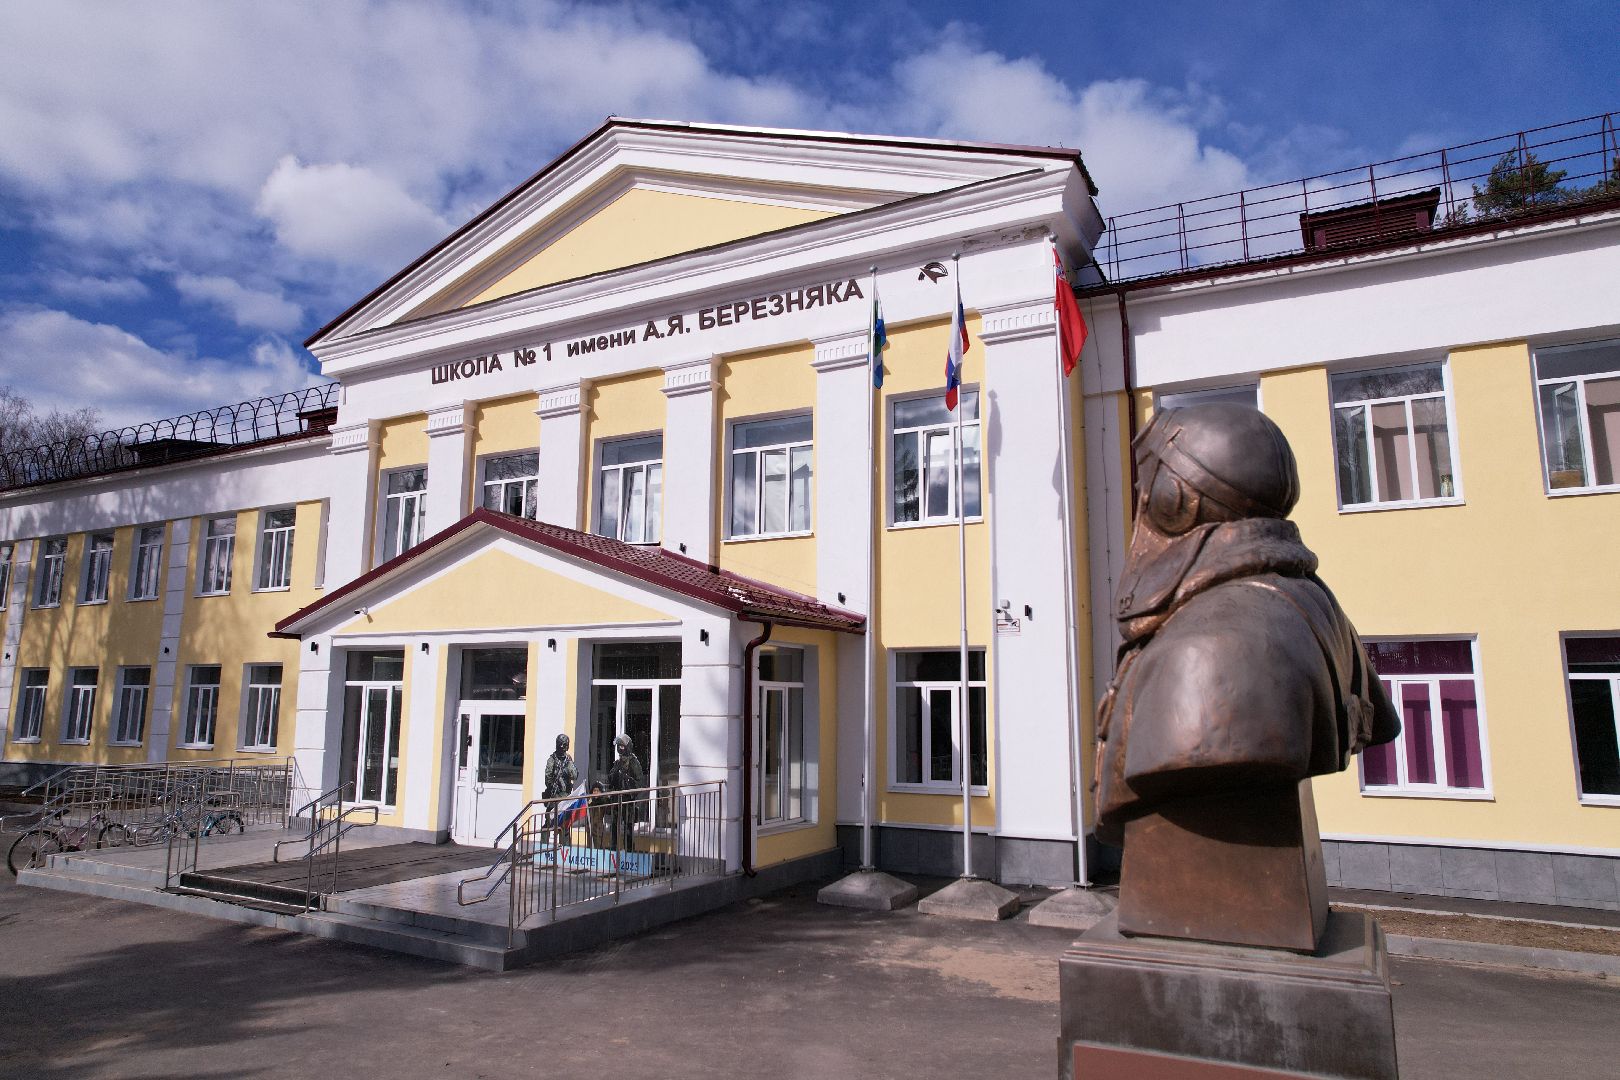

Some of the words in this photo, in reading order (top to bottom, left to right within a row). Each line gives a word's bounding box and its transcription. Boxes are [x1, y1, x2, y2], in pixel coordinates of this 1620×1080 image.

[431, 353, 503, 385] ШКОЛА
[513, 347, 537, 368] №
[542, 342, 552, 361] 1
[566, 329, 636, 358] имени
[642, 314, 691, 342] А.Я.
[699, 279, 865, 331] БЕРЕЗНЯКА
